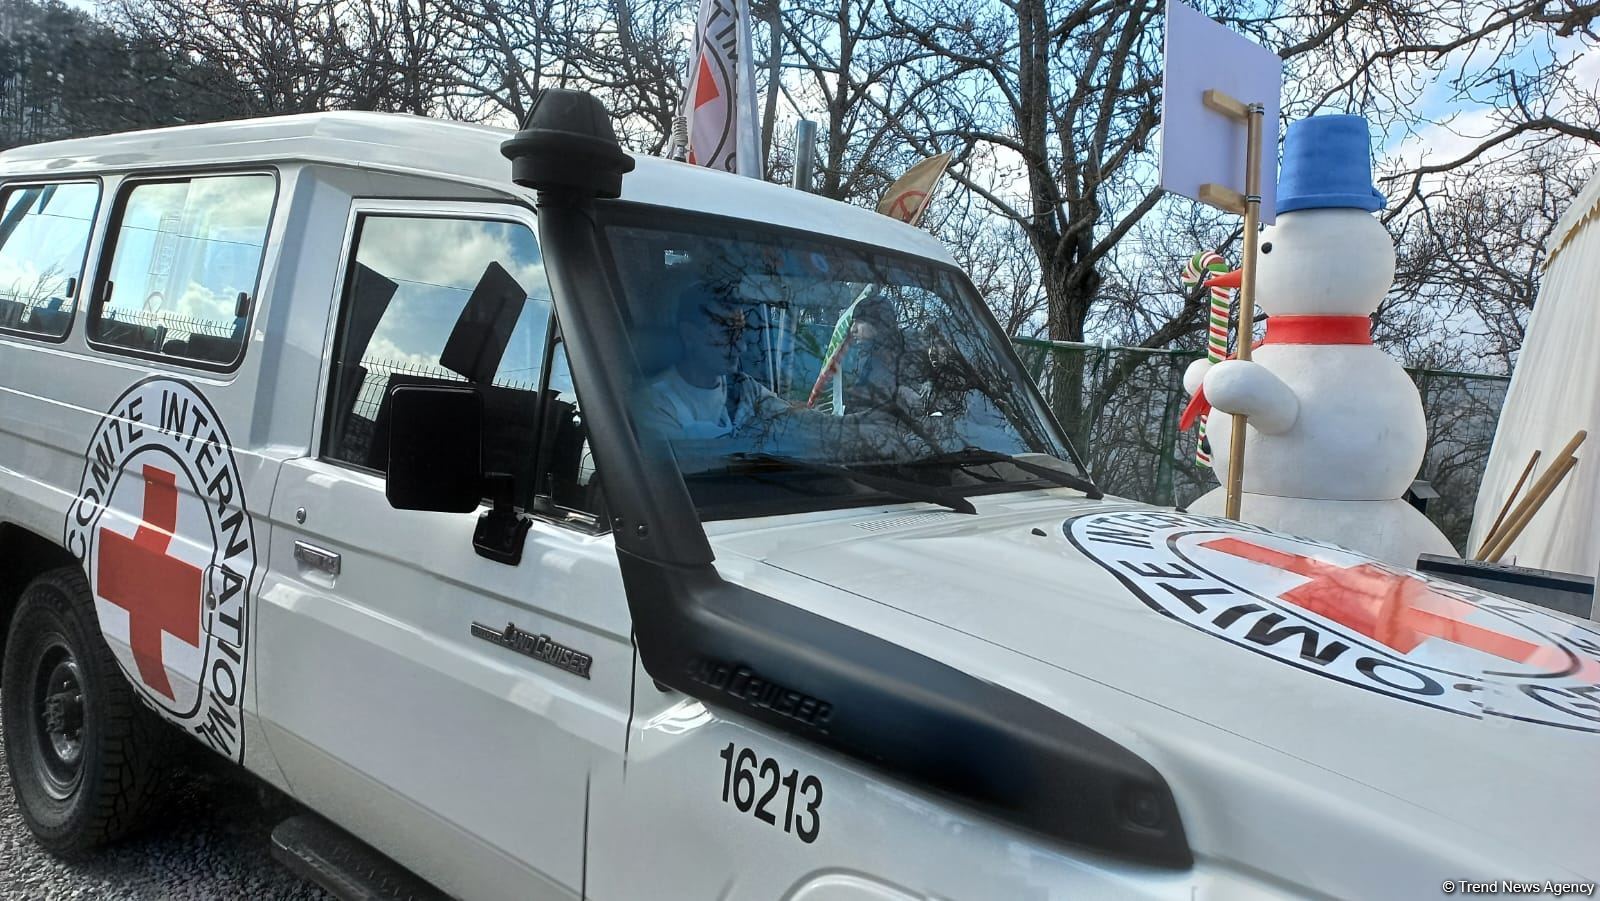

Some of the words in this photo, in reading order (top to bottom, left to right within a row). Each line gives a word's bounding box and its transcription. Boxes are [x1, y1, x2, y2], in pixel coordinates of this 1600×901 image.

[69, 396, 145, 559] COMITE
[158, 389, 249, 756] INTERNATIONAL
[535, 634, 590, 674] CRUISER
[719, 742, 824, 844] 16213
